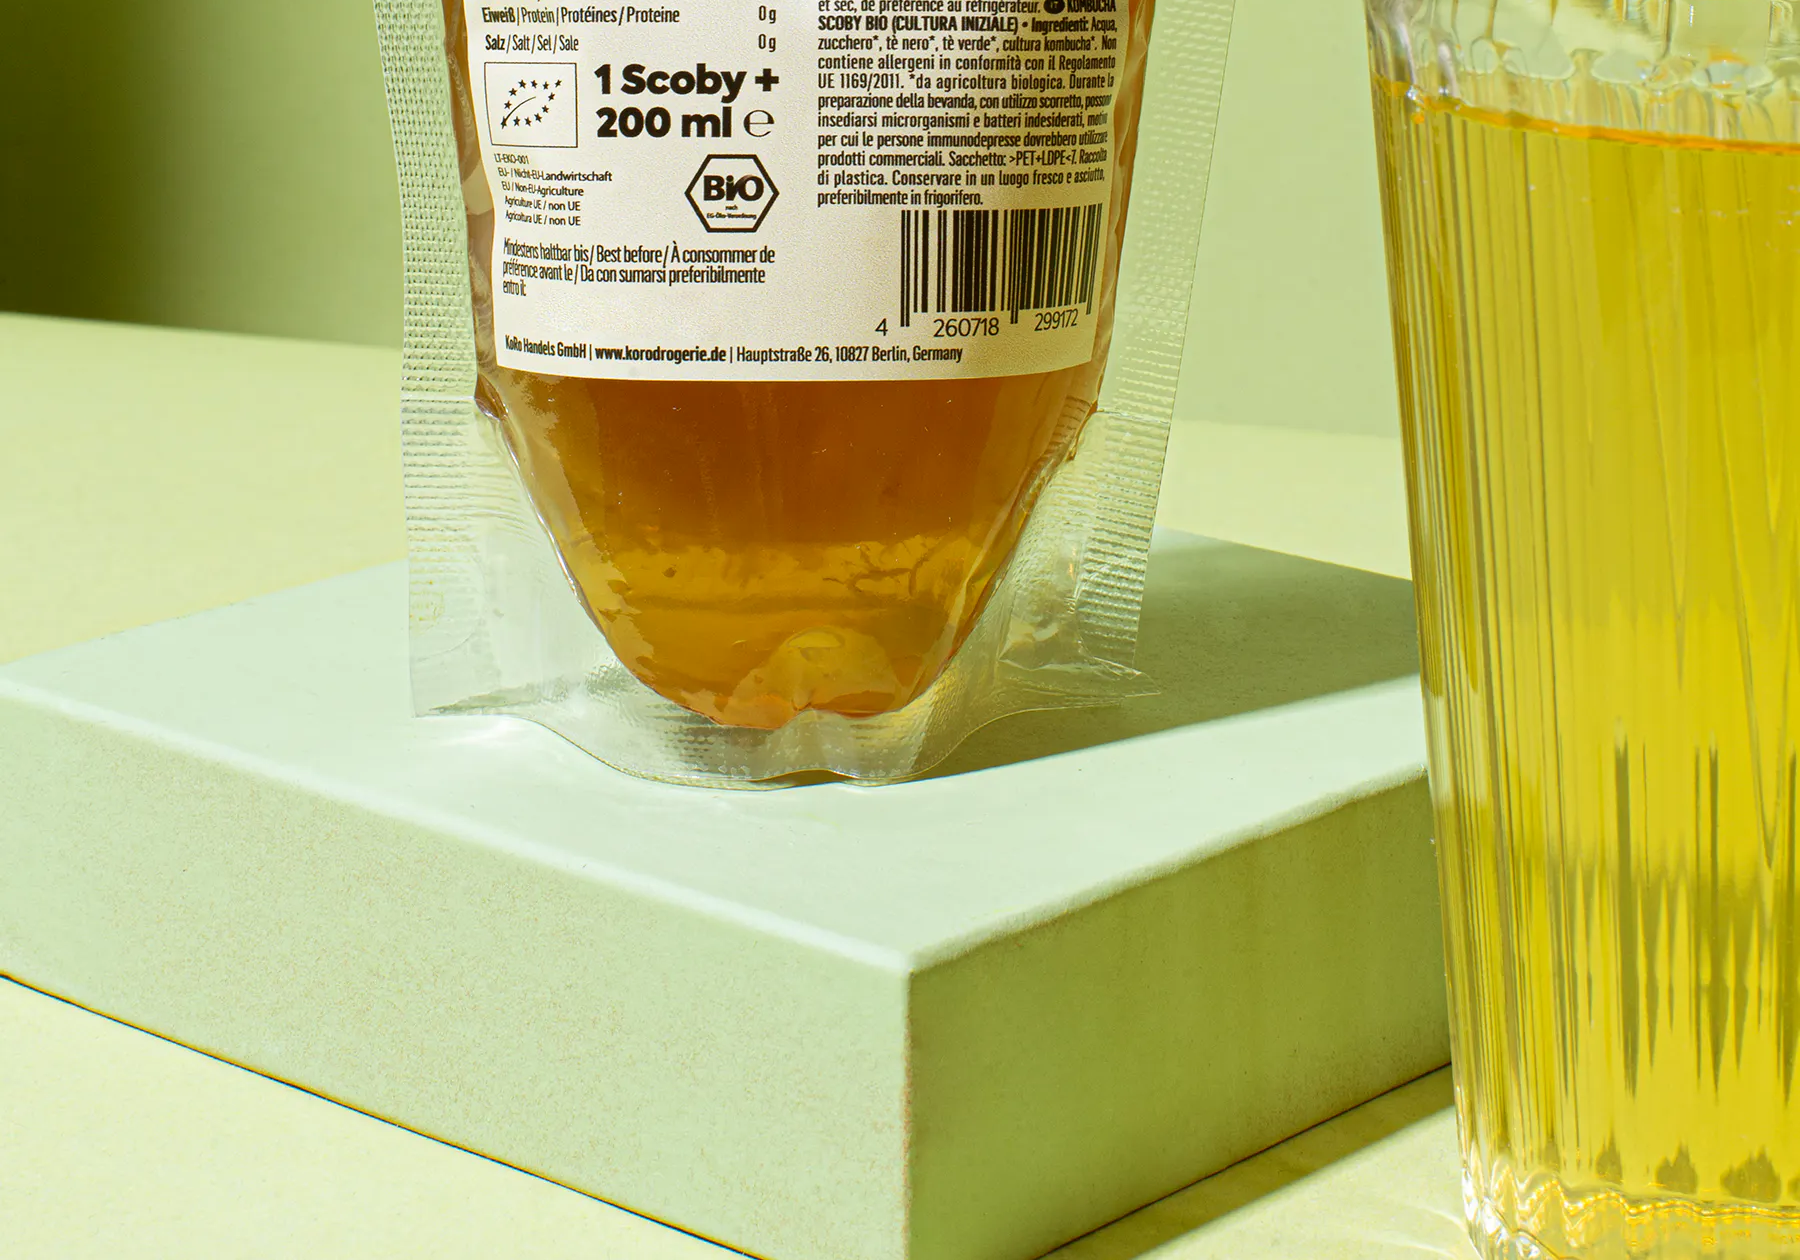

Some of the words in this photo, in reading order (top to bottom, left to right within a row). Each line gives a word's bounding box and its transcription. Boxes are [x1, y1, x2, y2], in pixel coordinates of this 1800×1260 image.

[594, 64, 610, 95] 1
[620, 64, 746, 103] Scoby
[755, 68, 779, 91] +
[596, 107, 671, 138] 200
[681, 106, 732, 138] ml
[548, 202, 566, 211] non
[567, 200, 580, 211] UE
[817, 191, 908, 208] preferibilmente
[910, 191, 922, 205] in
[924, 191, 983, 208] frigorifero.
[539, 243, 572, 261] haltbar
[596, 246, 622, 262] Best
[682, 250, 758, 263] consommer
[759, 247, 775, 264] de
[874, 319, 888, 337] 4
[933, 318, 999, 338] 260718
[1034, 308, 1078, 332] 299172
[505, 336, 522, 353] KoRo
[523, 338, 556, 357] Handels
[556, 342, 586, 359] GmbH
[594, 344, 726, 365] www.korodrogerie.de
[736, 347, 812, 365] Hauptstraße
[814, 347, 832, 363] 26,
[835, 346, 869, 361] 10827
[872, 346, 910, 362] Berlin,
[912, 345, 962, 364] Germany
